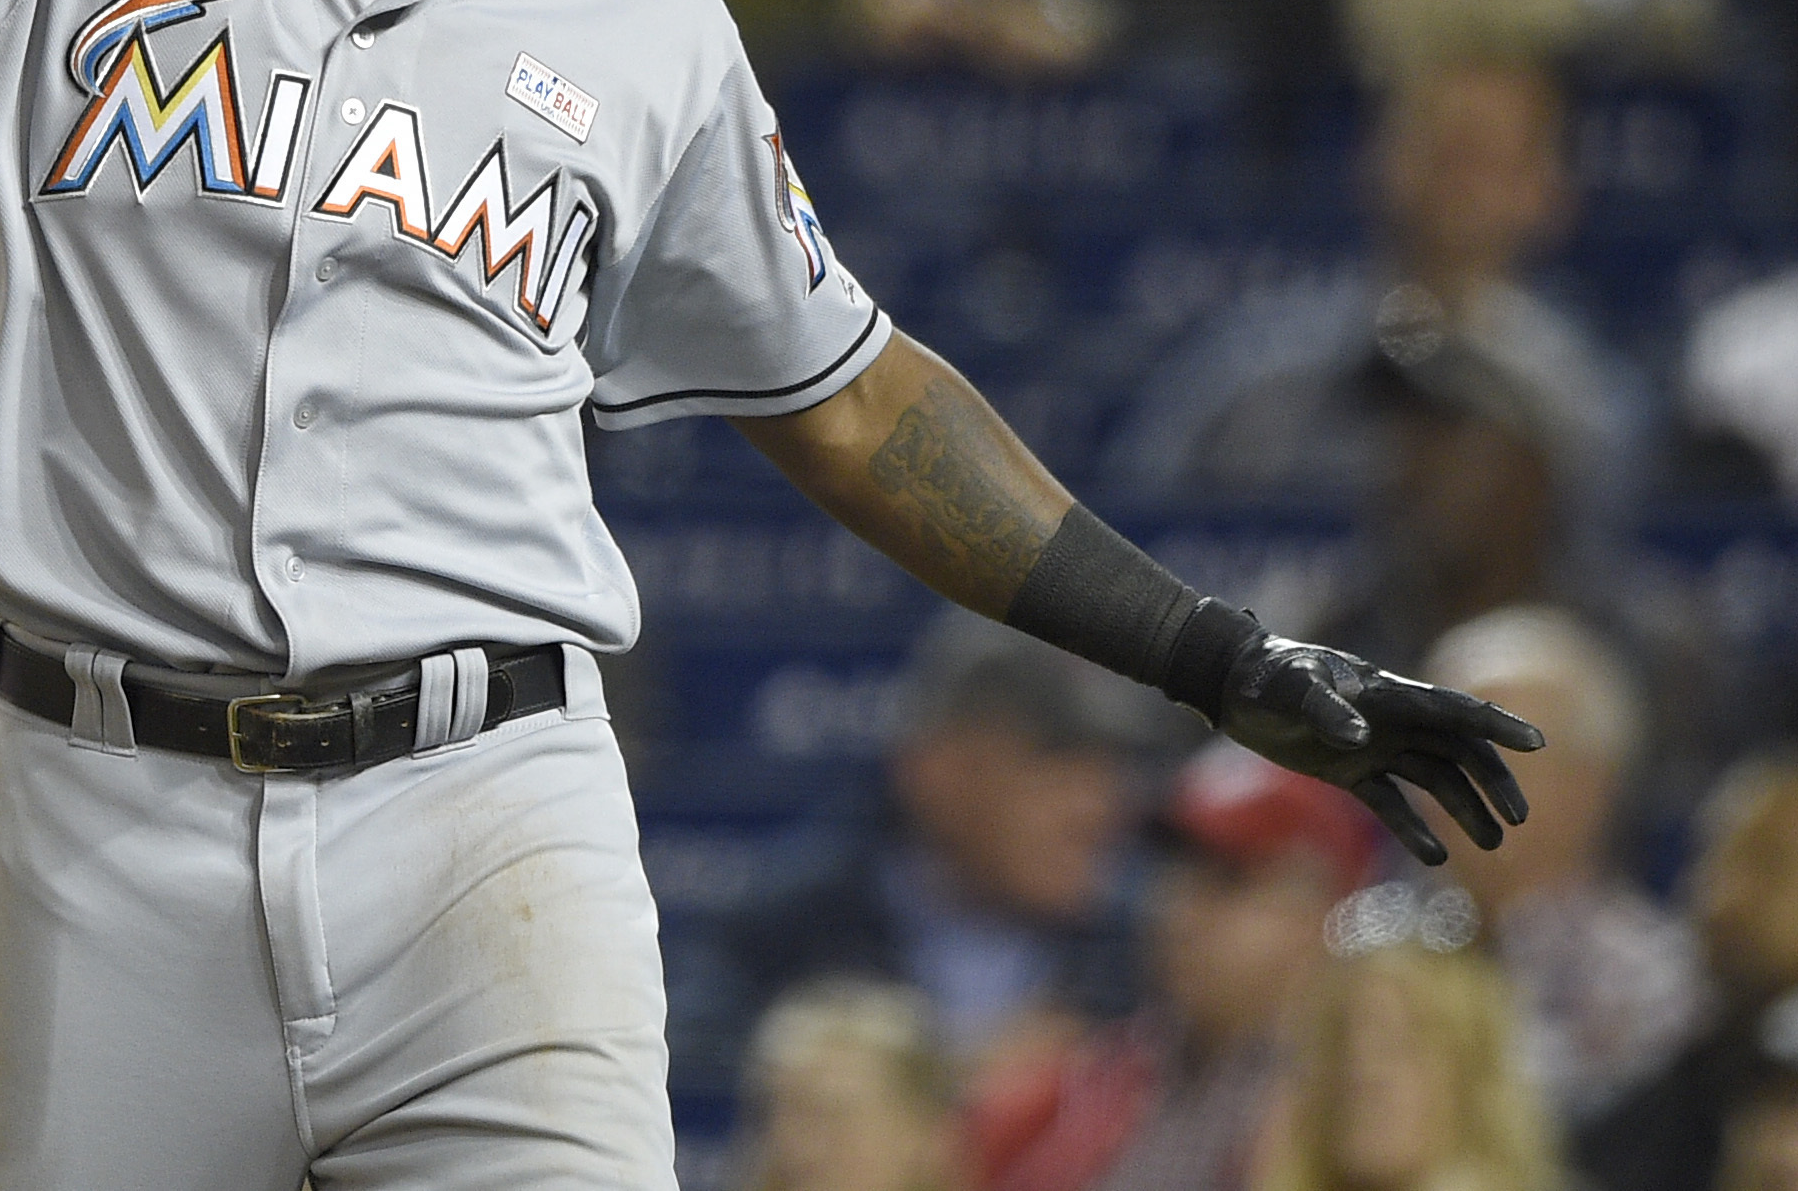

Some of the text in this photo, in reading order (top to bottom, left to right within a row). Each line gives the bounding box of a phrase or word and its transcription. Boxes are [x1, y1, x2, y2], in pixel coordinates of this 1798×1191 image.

[30, 18, 597, 337] MIAMI
[516, 68, 554, 102] PLAY
[552, 92, 586, 127] BALL
